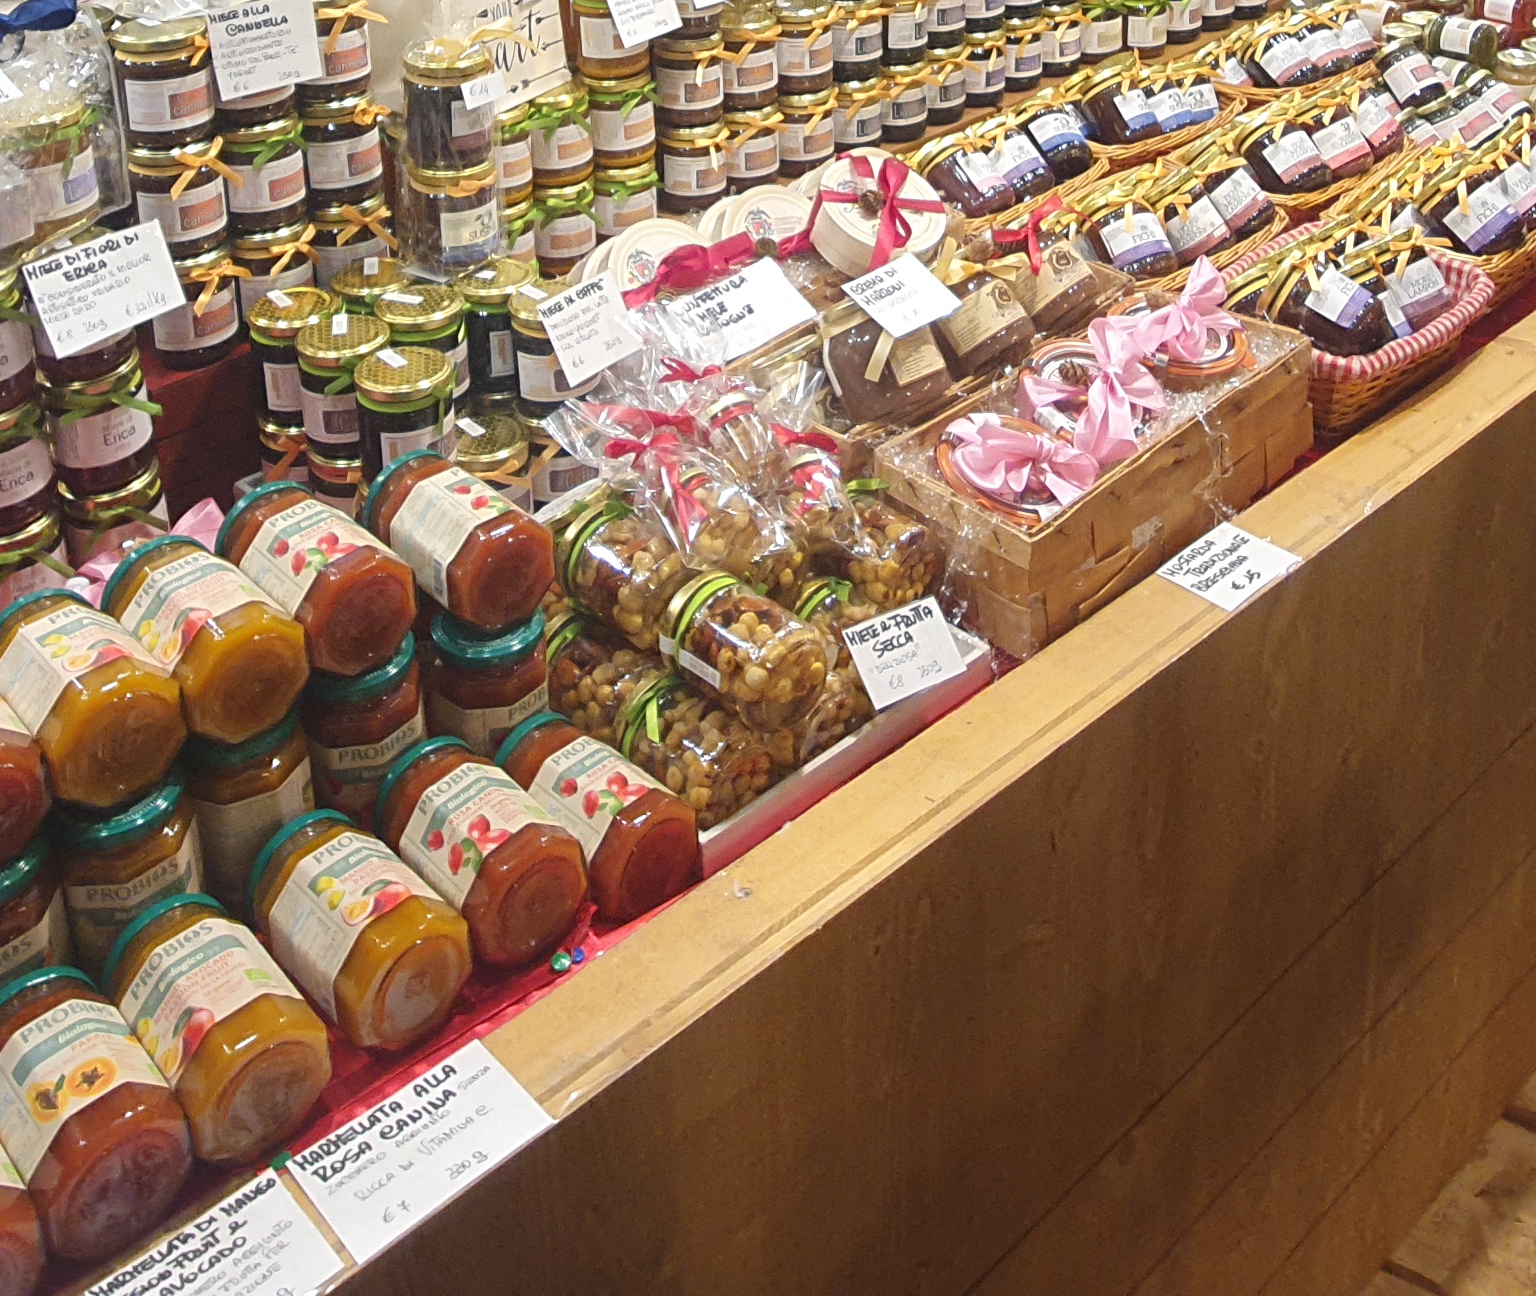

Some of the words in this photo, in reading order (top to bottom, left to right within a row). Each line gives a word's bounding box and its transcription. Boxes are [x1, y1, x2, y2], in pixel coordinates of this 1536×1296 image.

[225, 15, 290, 37] CANNELLA
[242, 4, 270, 18] ALLA
[65, 253, 82, 266] DI
[80, 238, 121, 260] FIORI
[123, 232, 140, 246] DI
[62, 259, 108, 283] ERICA
[103, 426, 137, 447] Erica
[267, 501, 318, 530] PROB
[1161, 539, 1217, 578] MOSTARDA
[872, 631, 914, 659] SECCA
[507, 686, 547, 721] PROB
[338, 725, 417, 766] PROBIOS
[550, 736, 597, 767] PROB
[417, 764, 488, 817] PROBIO
[85, 855, 180, 902] PROBIOS
[128, 921, 215, 1002] PROBIOS
[293, 1100, 404, 1172] MARMELLATA
[412, 1064, 458, 1099] ALLA
[310, 1140, 373, 1183] ROSA
[379, 1088, 458, 1141] CANINA
[353, 1171, 397, 1202] RICCA
[417, 1115, 476, 1157] VITAMINA
[193, 1214, 219, 1232] DI
[158, 1235, 248, 1296] AVOCADO
